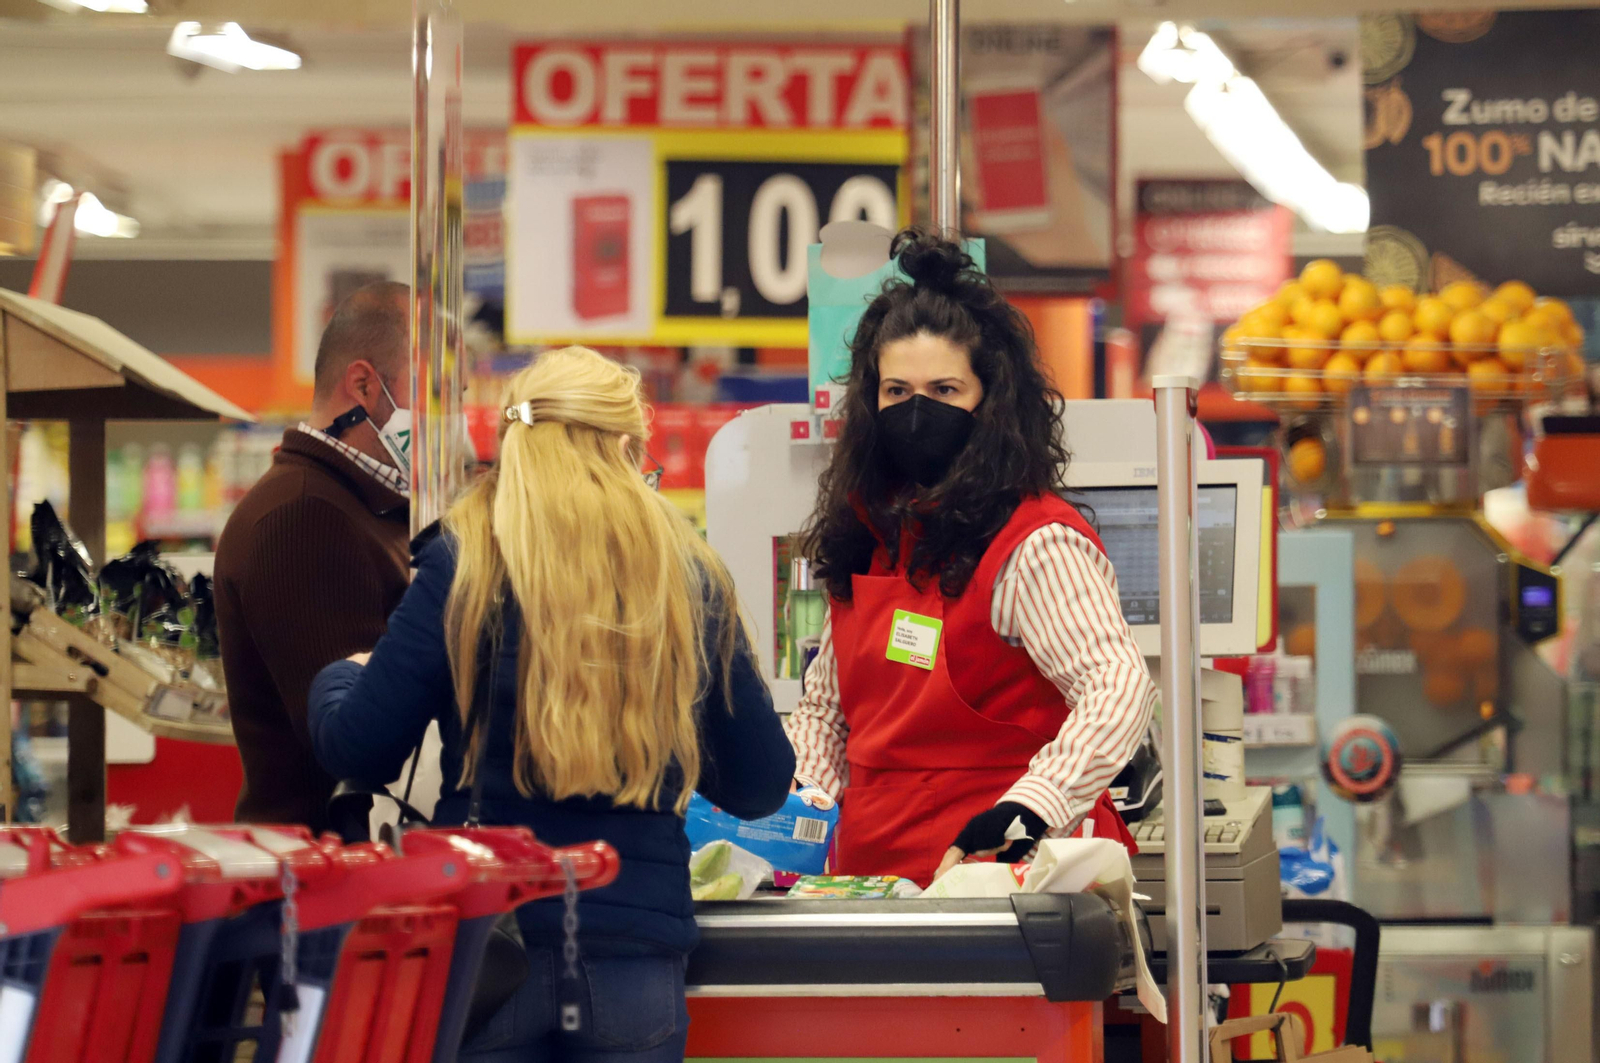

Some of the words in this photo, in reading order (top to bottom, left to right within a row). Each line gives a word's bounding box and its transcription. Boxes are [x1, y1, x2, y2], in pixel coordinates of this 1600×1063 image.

[523, 50, 907, 128] OFERTA
[1442, 88, 1549, 125] Zumo
[1553, 91, 1600, 123] de
[1538, 130, 1600, 173] NA
[1133, 467, 1156, 478] IBM
